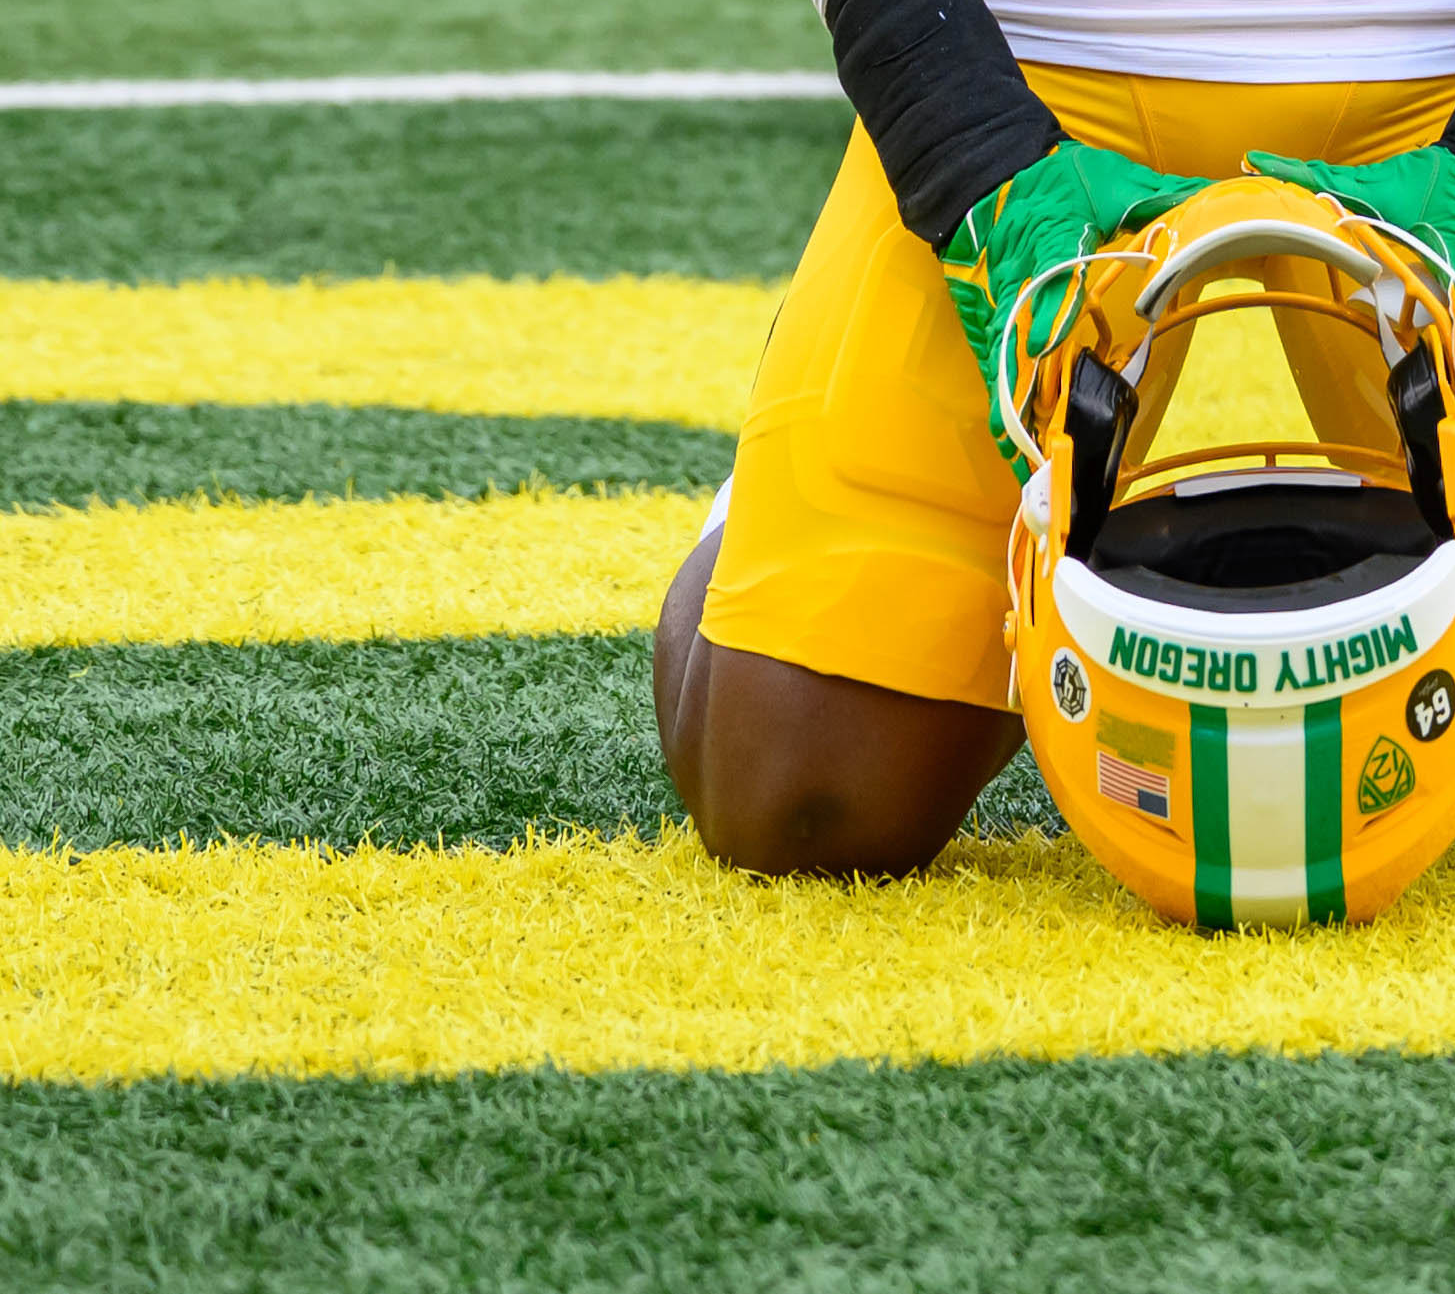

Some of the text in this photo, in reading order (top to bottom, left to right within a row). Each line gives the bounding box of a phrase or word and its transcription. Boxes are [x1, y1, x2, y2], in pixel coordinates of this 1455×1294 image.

[1108, 612, 1420, 694] MIGHTY OREGON
[1413, 686, 1452, 738] 64
[1362, 756, 1413, 810] PAC
[1371, 748, 1399, 780] 12
